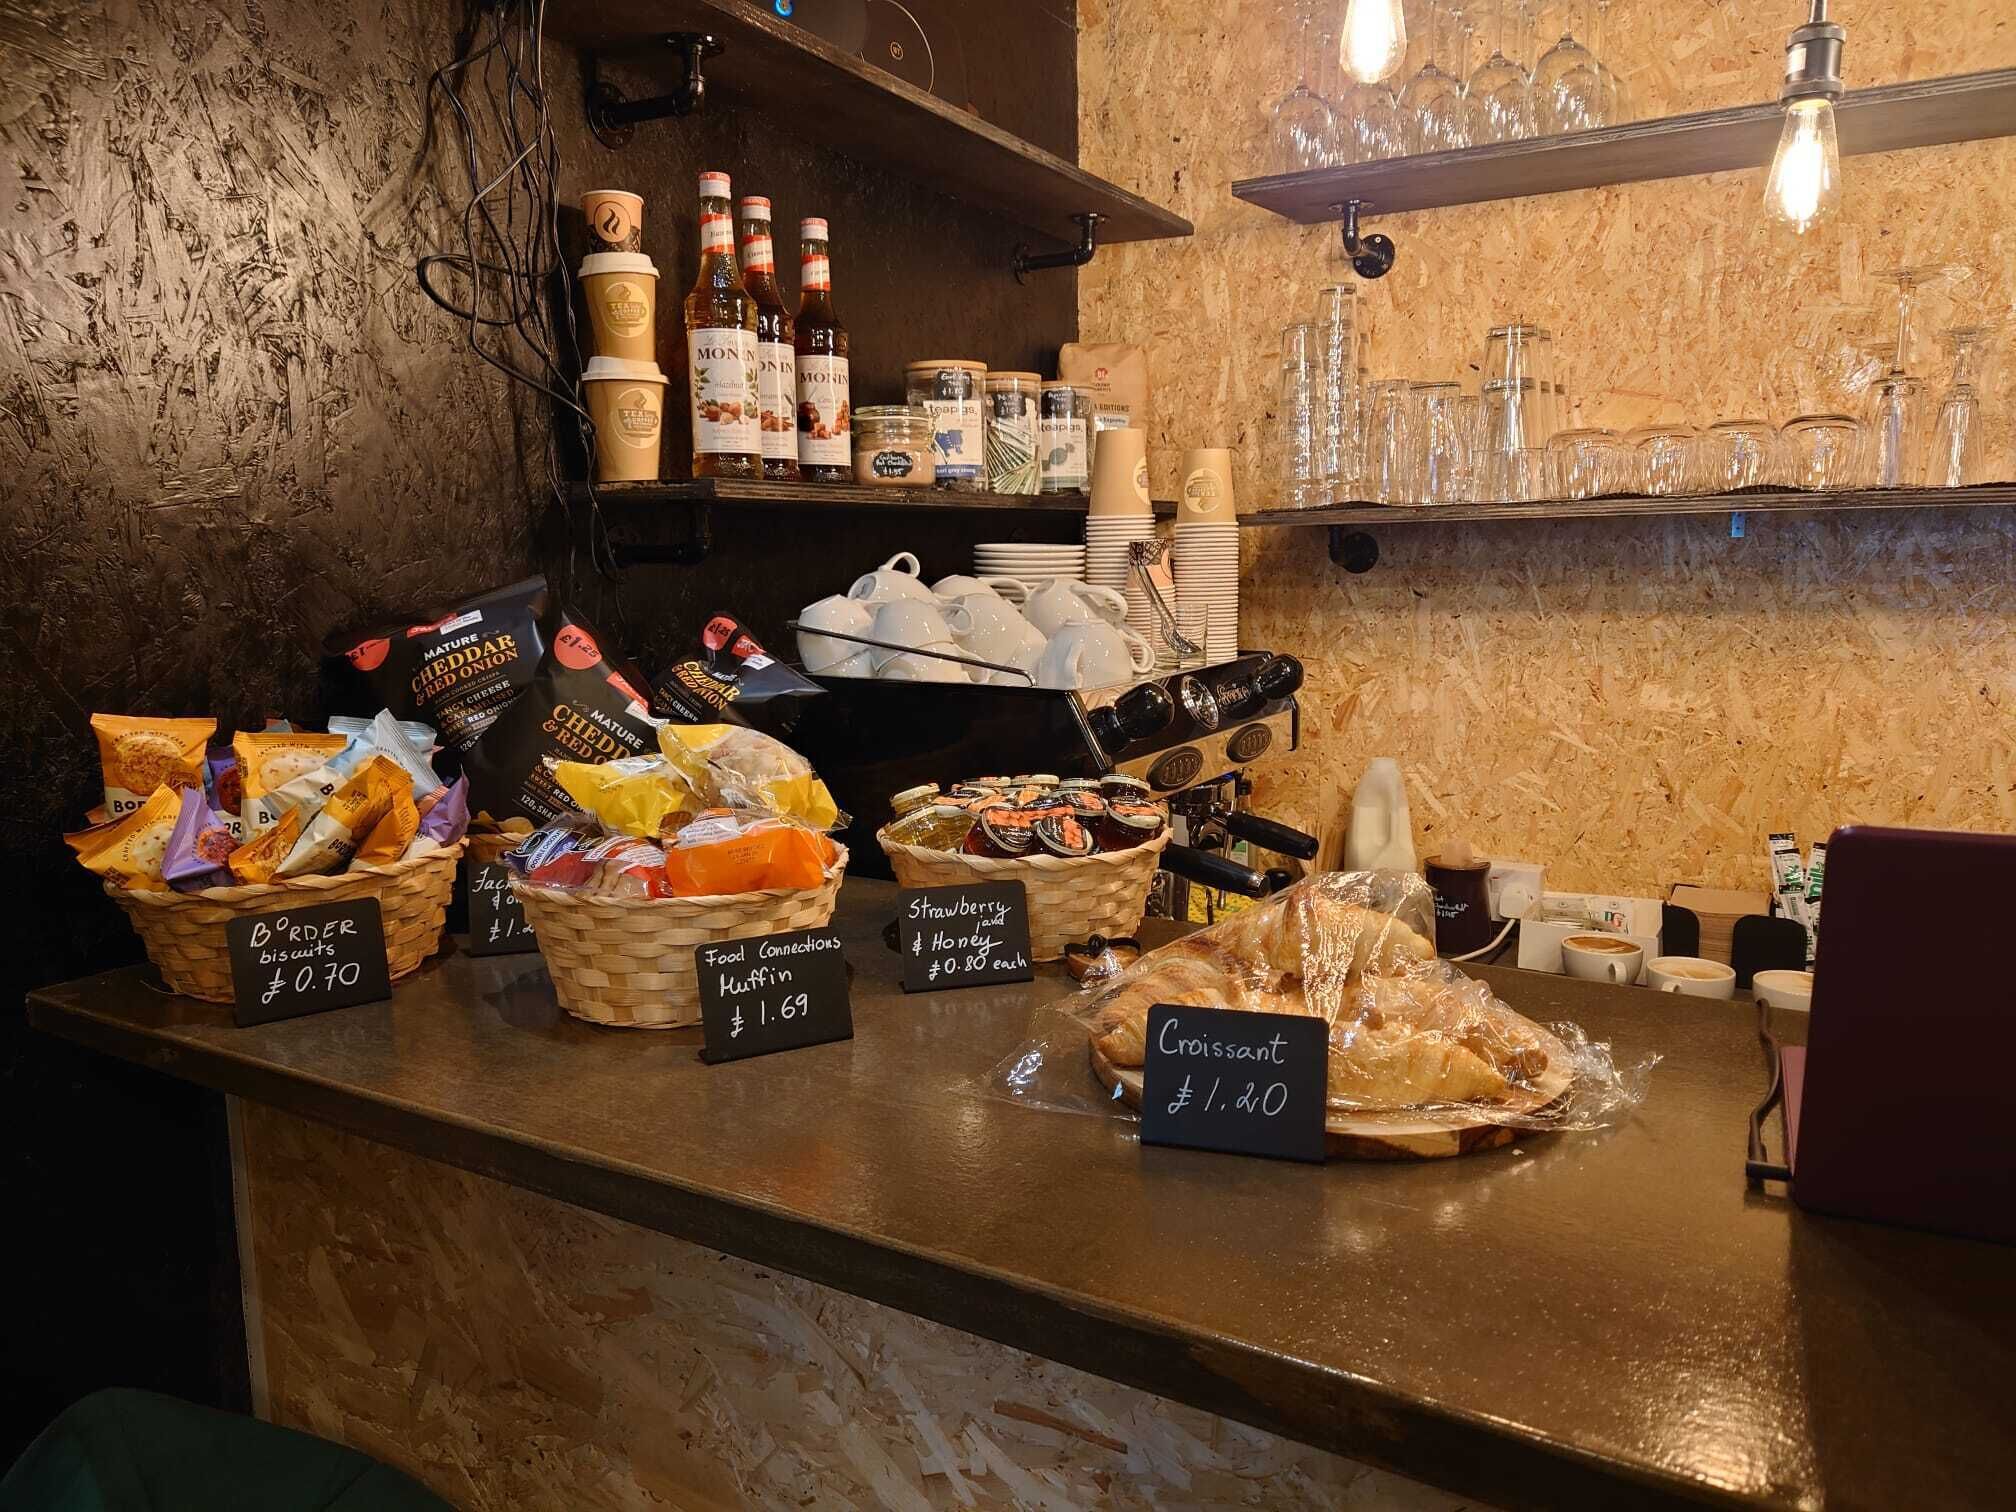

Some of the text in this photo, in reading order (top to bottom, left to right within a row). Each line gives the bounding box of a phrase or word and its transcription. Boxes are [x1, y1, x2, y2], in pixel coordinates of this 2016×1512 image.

[697, 347, 756, 361] MONN
[800, 372, 849, 385] MONIN
[424, 633, 480, 661] MATURE
[560, 634, 600, 658] £1.25
[411, 634, 516, 693] CHEDDAR
[424, 673, 457, 699] RED
[459, 647, 520, 679] ONION
[466, 681, 511, 704] CHEESE
[467, 711, 486, 723] RED
[590, 709, 644, 749] MATURE
[543, 719, 558, 733] &
[557, 729, 593, 758] RED
[553, 788, 570, 803] RED
[908, 895, 1012, 920] Strawberry
[250, 916, 358, 948] BORDER
[931, 930, 1004, 957] Honey
[259, 939, 336, 965] biscuits
[705, 934, 842, 967] Food Connections
[993, 951, 1028, 970] each
[720, 965, 793, 998] Muffin
[1159, 1017, 1289, 1065] Croissant
